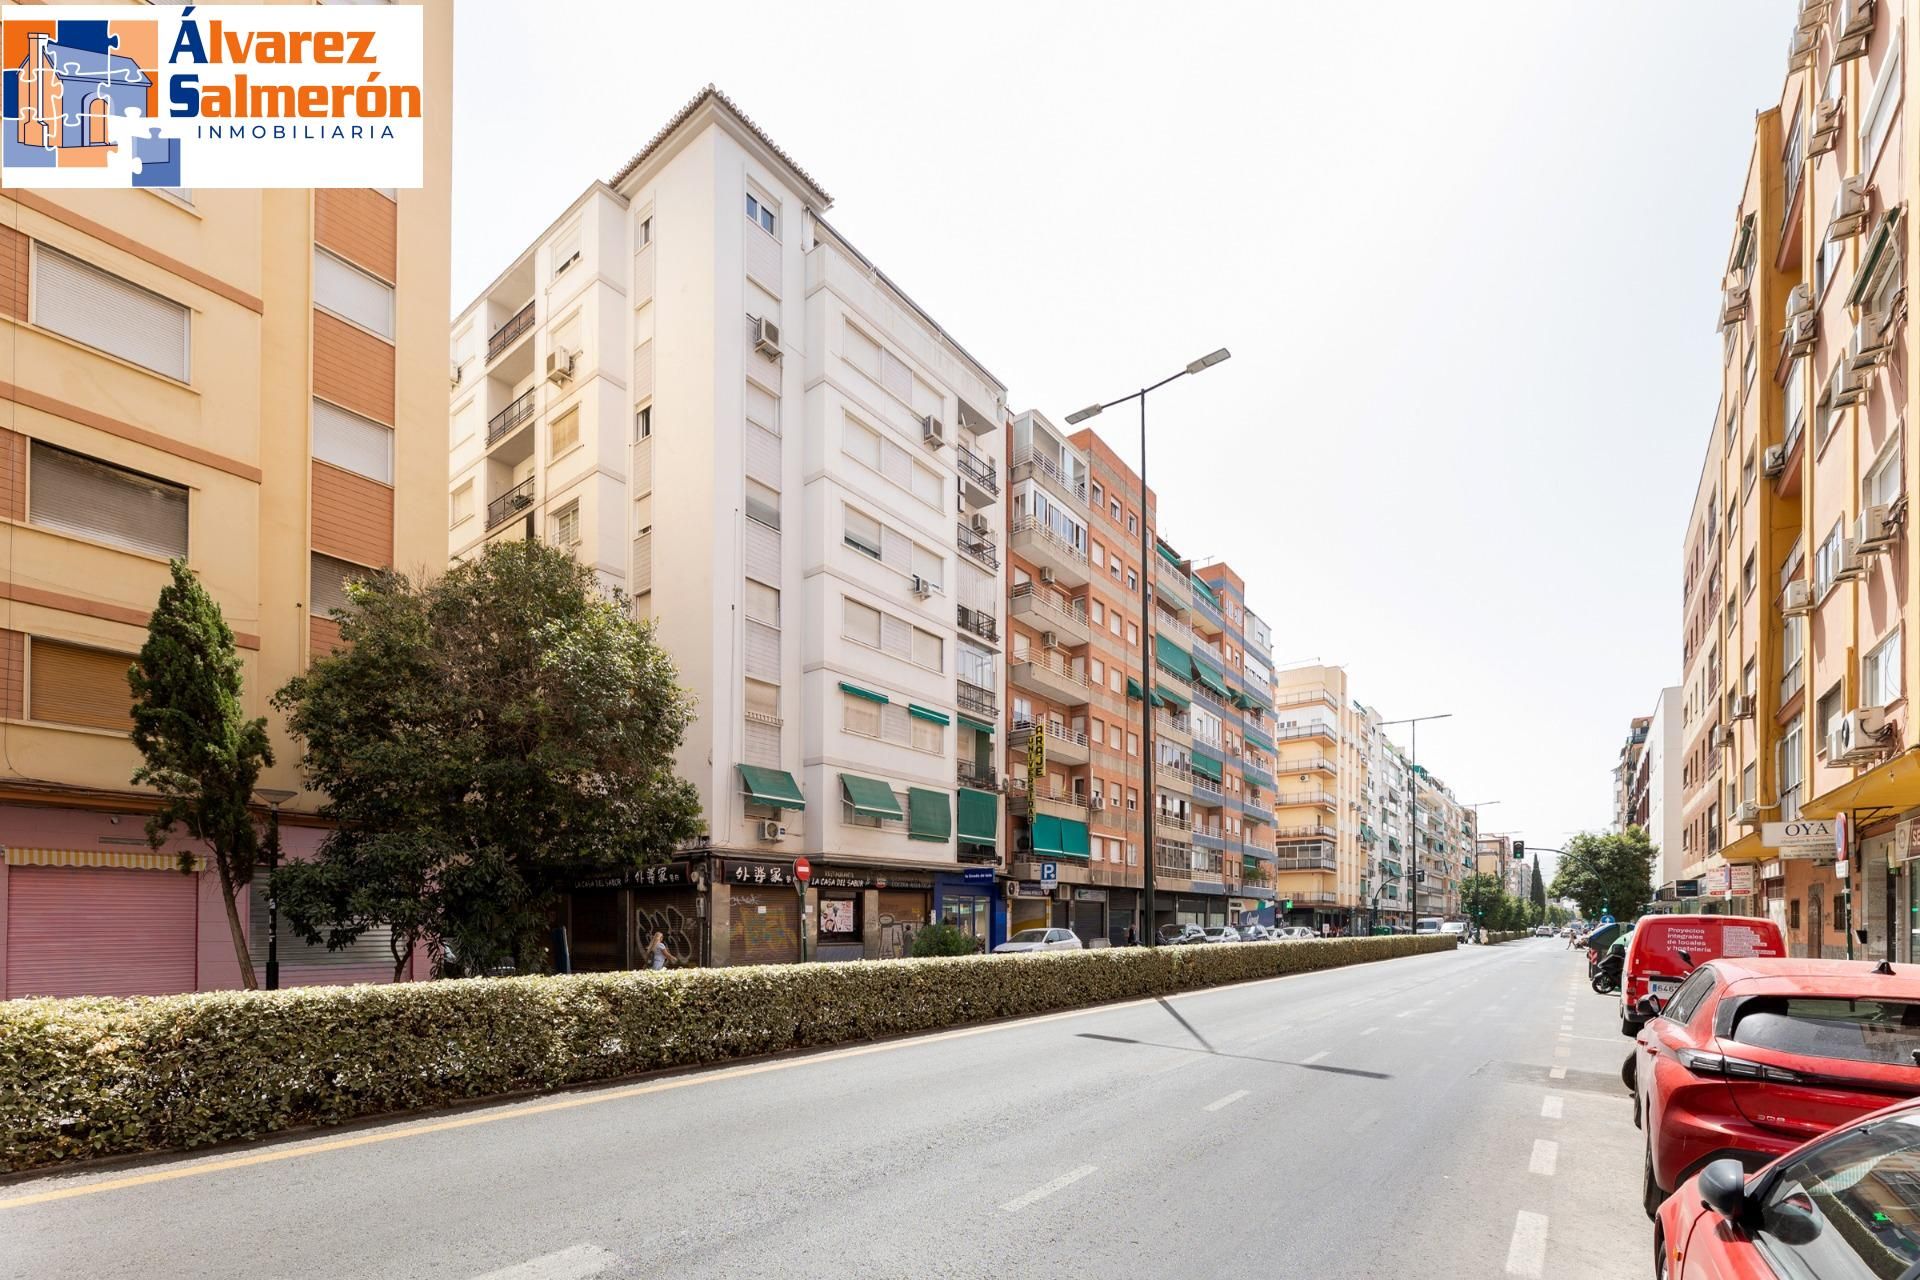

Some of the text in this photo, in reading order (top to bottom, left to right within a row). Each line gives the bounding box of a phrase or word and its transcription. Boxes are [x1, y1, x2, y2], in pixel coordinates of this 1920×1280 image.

[1785, 822, 1829, 836] OYA
[811, 877, 864, 888] LA CASA DEL SABOR
